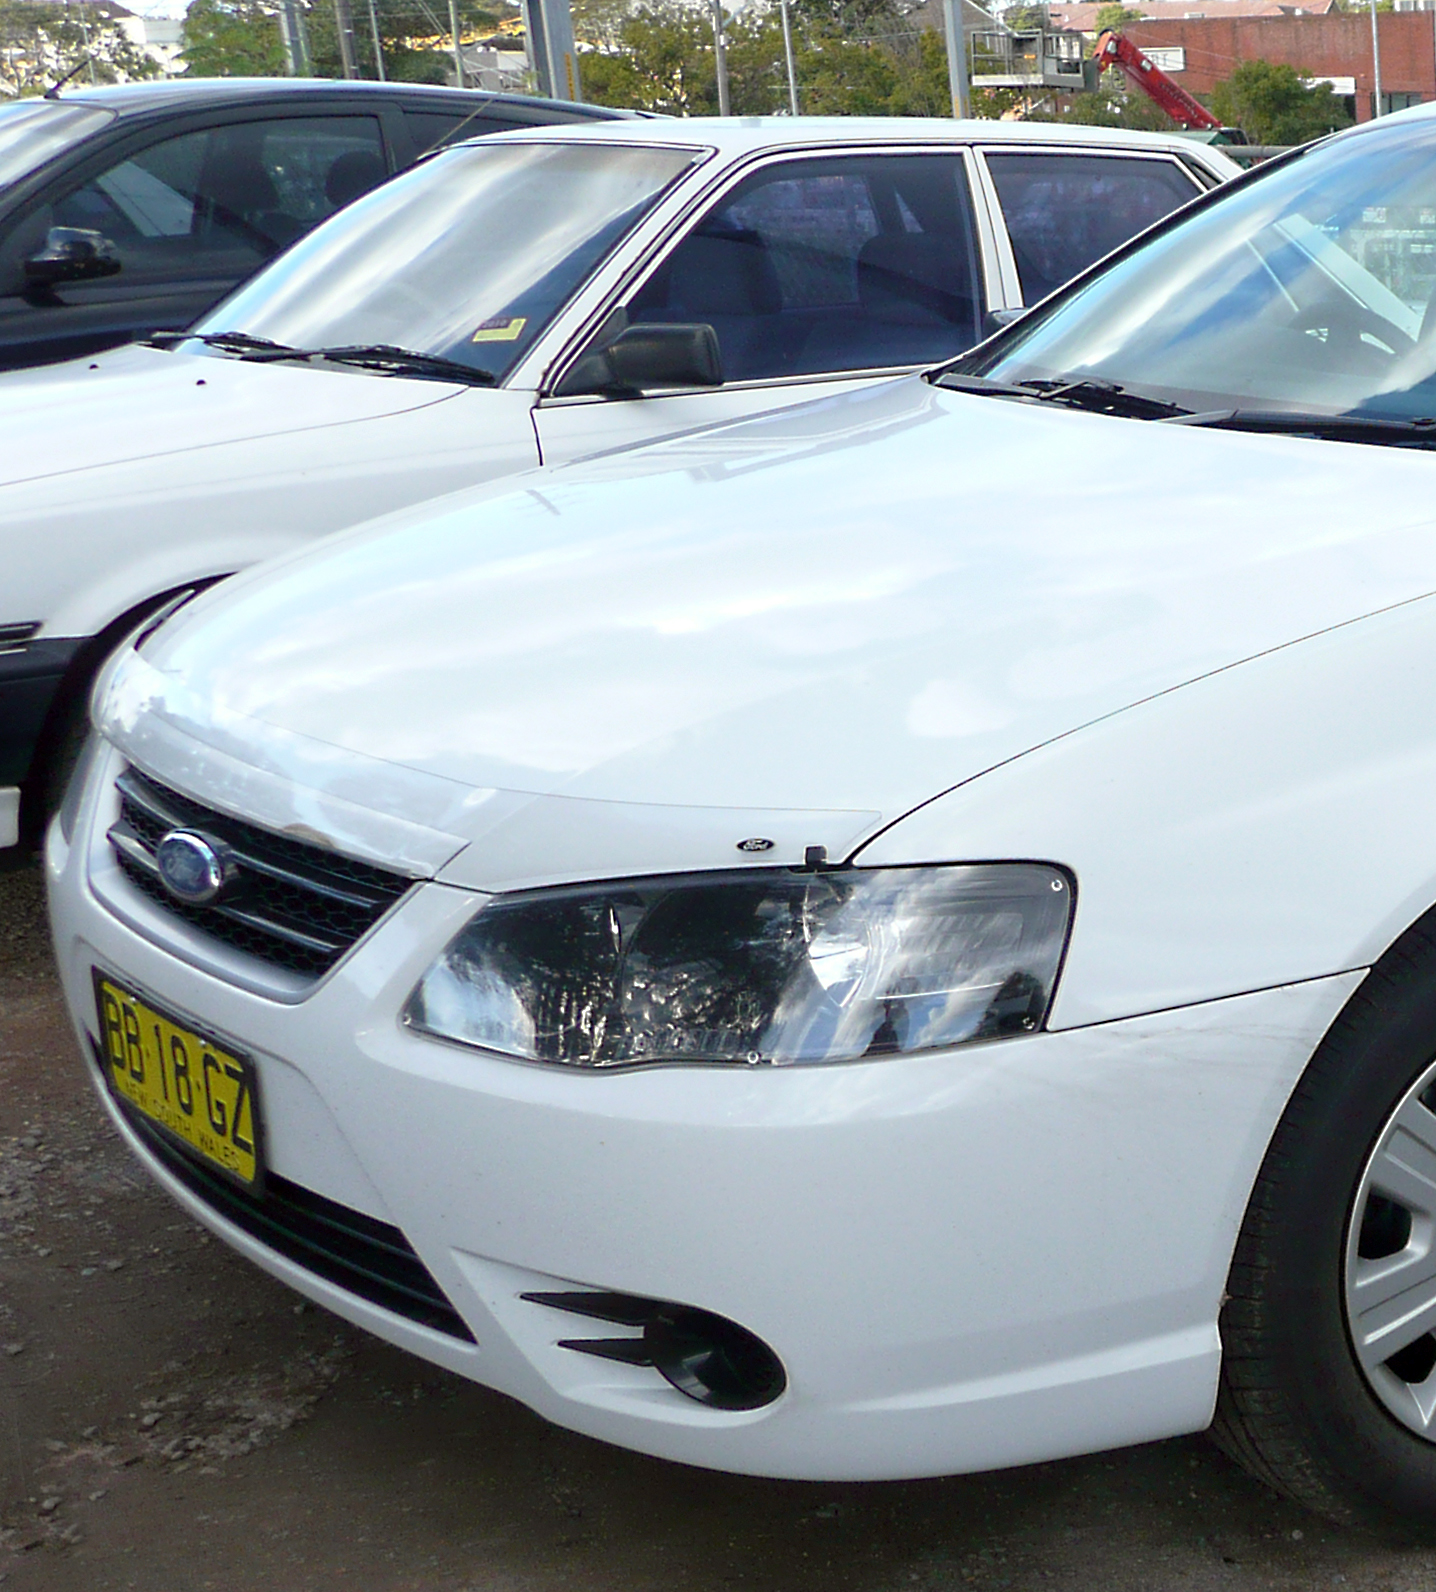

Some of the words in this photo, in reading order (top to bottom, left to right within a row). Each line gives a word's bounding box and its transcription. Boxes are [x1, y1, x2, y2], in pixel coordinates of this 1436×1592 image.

[743, 840, 769, 851] Ford
[125, 1081, 147, 1105] NEW
[153, 1099, 192, 1133] SOUTH
[198, 1129, 241, 1171] WALES
